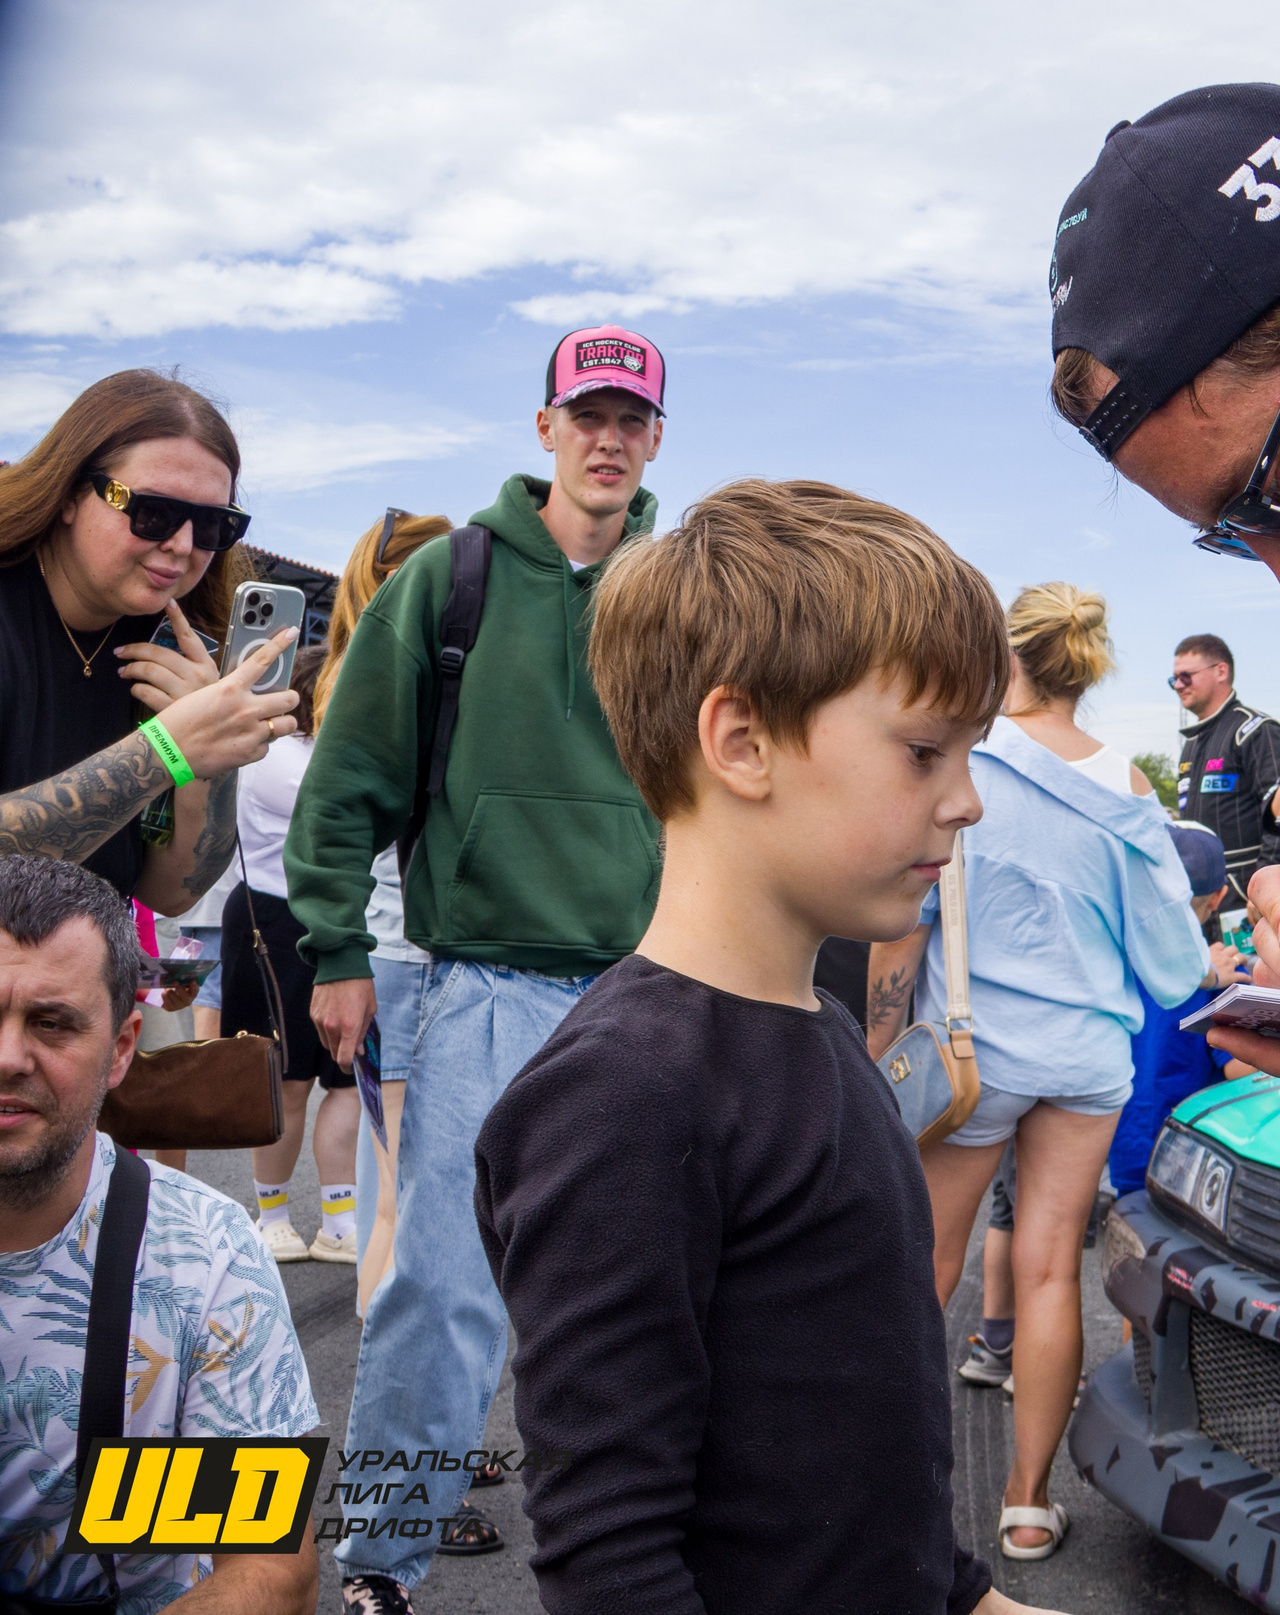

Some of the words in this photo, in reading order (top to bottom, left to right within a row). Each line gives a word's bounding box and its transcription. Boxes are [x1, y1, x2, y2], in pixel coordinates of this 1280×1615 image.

[624, 341, 641, 352] CLUB
[148, 725, 179, 764] ПРЕМИУМ
[1204, 779, 1231, 788] RED
